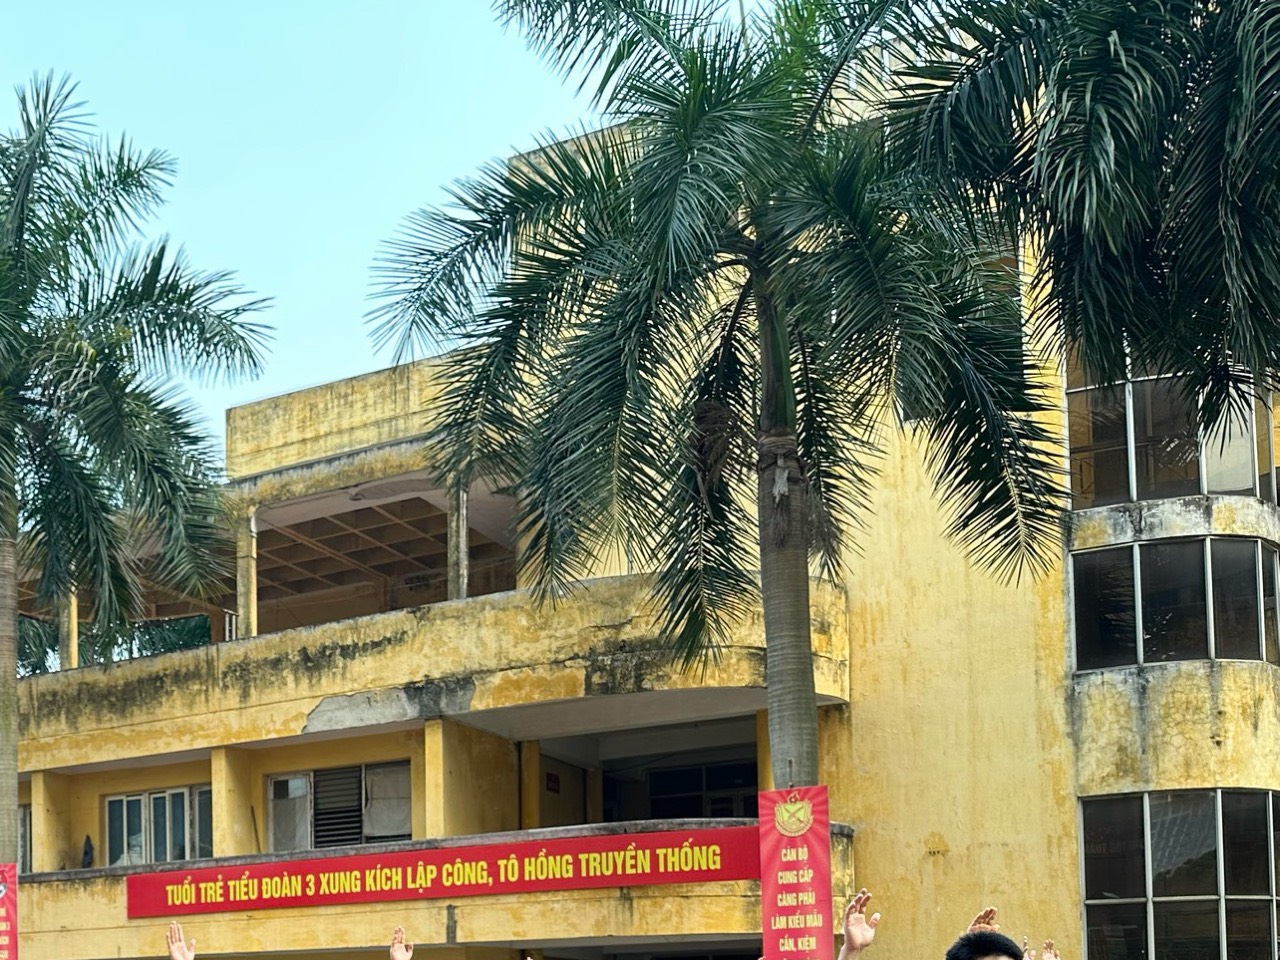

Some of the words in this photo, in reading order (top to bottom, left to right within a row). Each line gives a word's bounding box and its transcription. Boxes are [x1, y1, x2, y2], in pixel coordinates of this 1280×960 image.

[781, 845, 797, 862] CÁN
[798, 844, 809, 863] BỘ
[165, 875, 196, 906] TUỔI
[199, 874, 224, 904] TRẺ
[227, 870, 258, 901] TIỂU
[261, 871, 302, 899] ĐOÀN
[306, 874, 315, 896] 3
[319, 870, 361, 895] XUNG
[365, 863, 402, 892] KÍCH
[406, 860, 437, 893] LẬP
[441, 858, 493, 887] CÔNG,
[497, 853, 519, 883] TÔ
[523, 848, 574, 881] HỒNG
[578, 842, 651, 877] TRUYỀN
[655, 837, 721, 873] THỐNG
[777, 870, 798, 885] CUNG
[777, 890, 797, 907] CÀNG
[771, 913, 787, 930] LÀM
